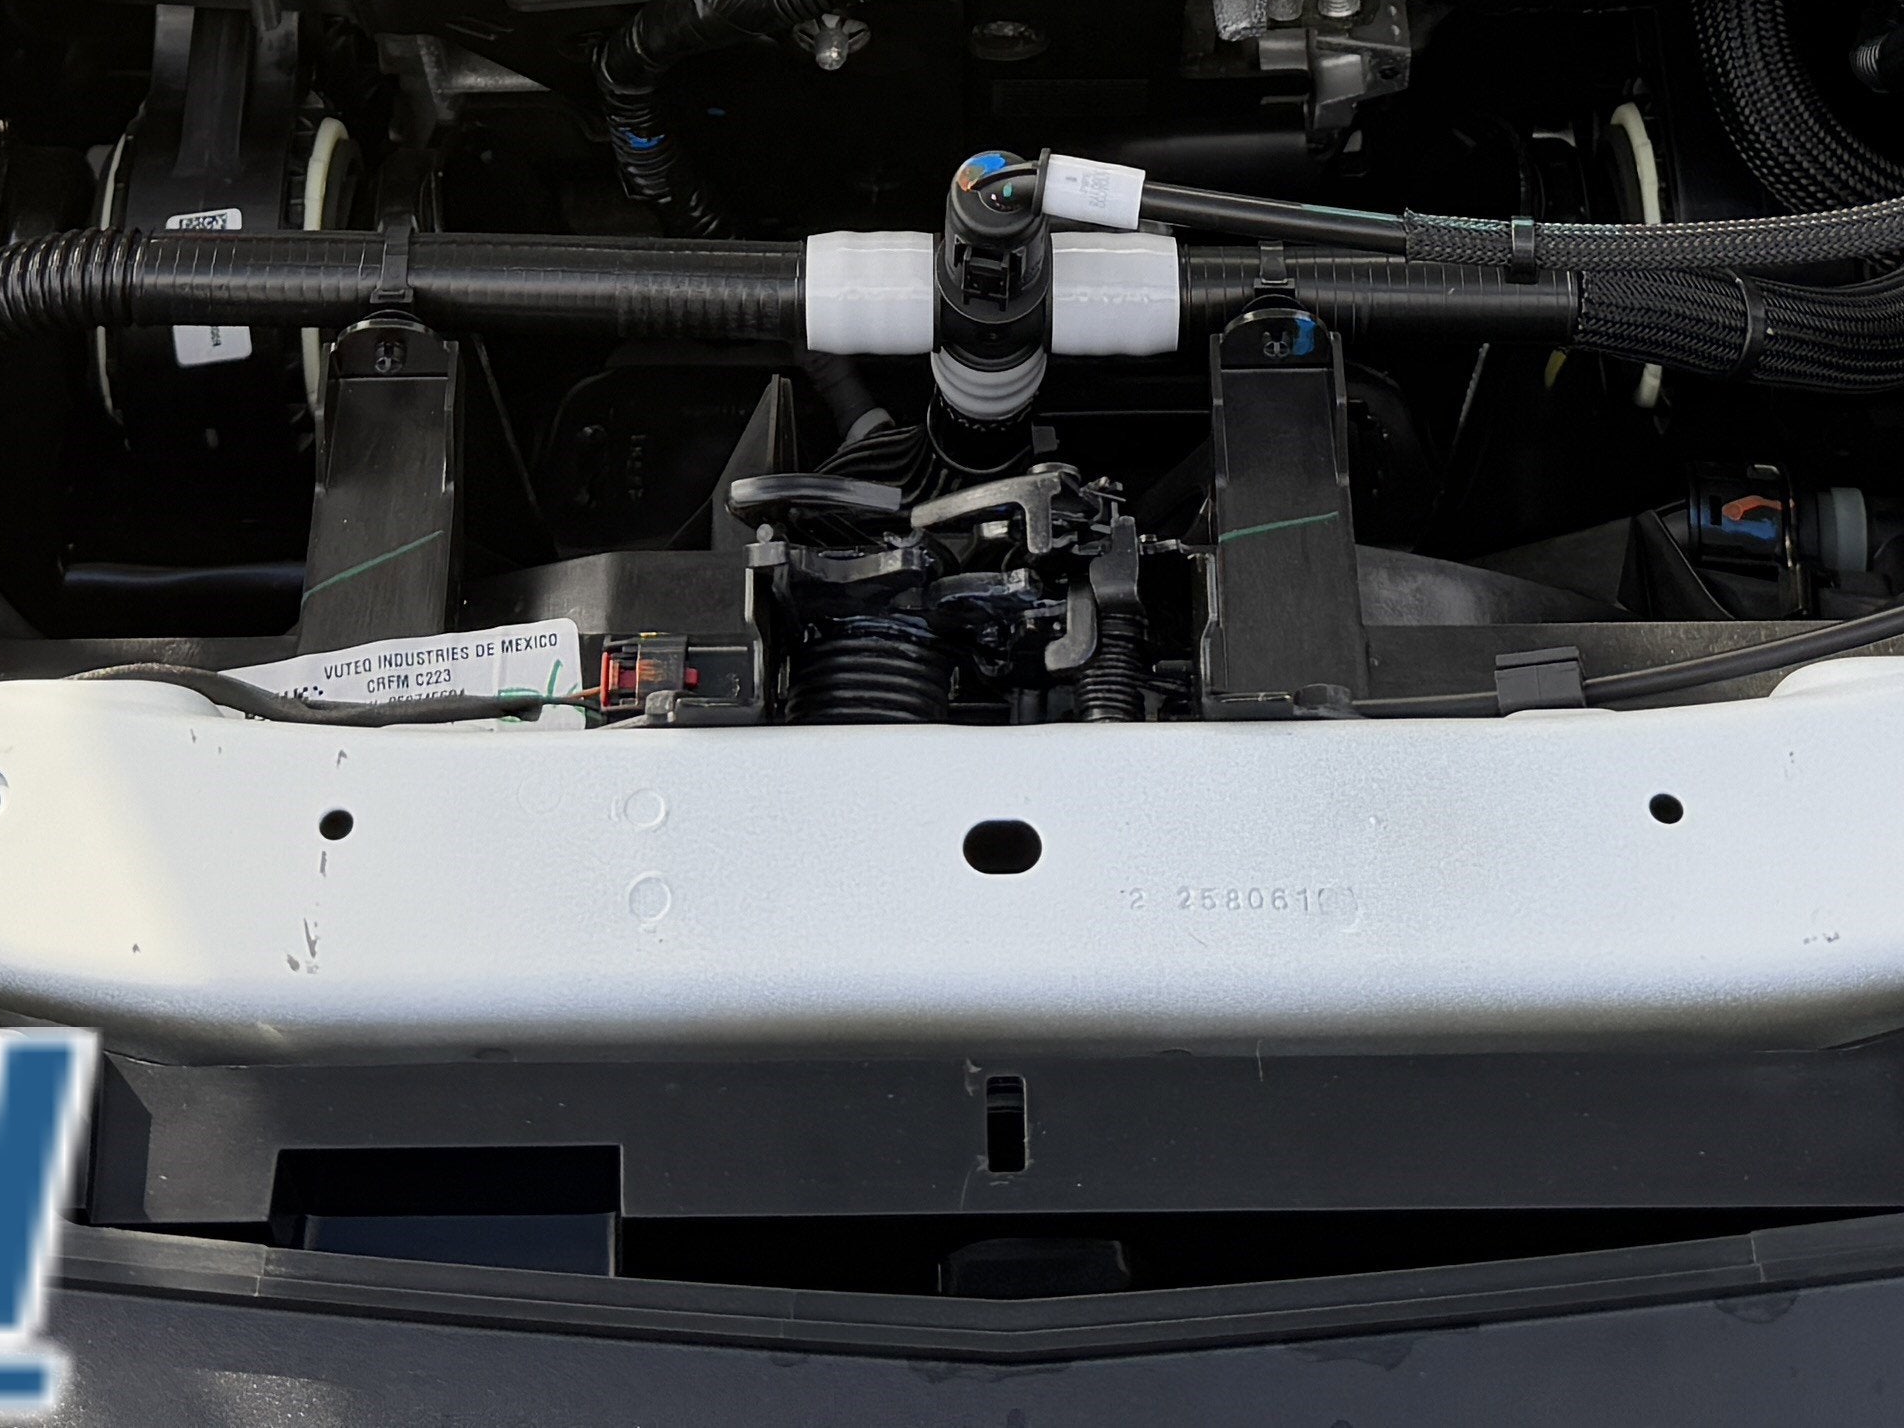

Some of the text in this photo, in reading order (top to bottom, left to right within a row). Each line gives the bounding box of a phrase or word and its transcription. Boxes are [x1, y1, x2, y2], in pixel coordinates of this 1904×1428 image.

[377, 645, 470, 671] INDUSTRIES
[475, 641, 495, 657] DE
[501, 632, 559, 655] MEXICO
[366, 668, 452, 694] CRFM C223
